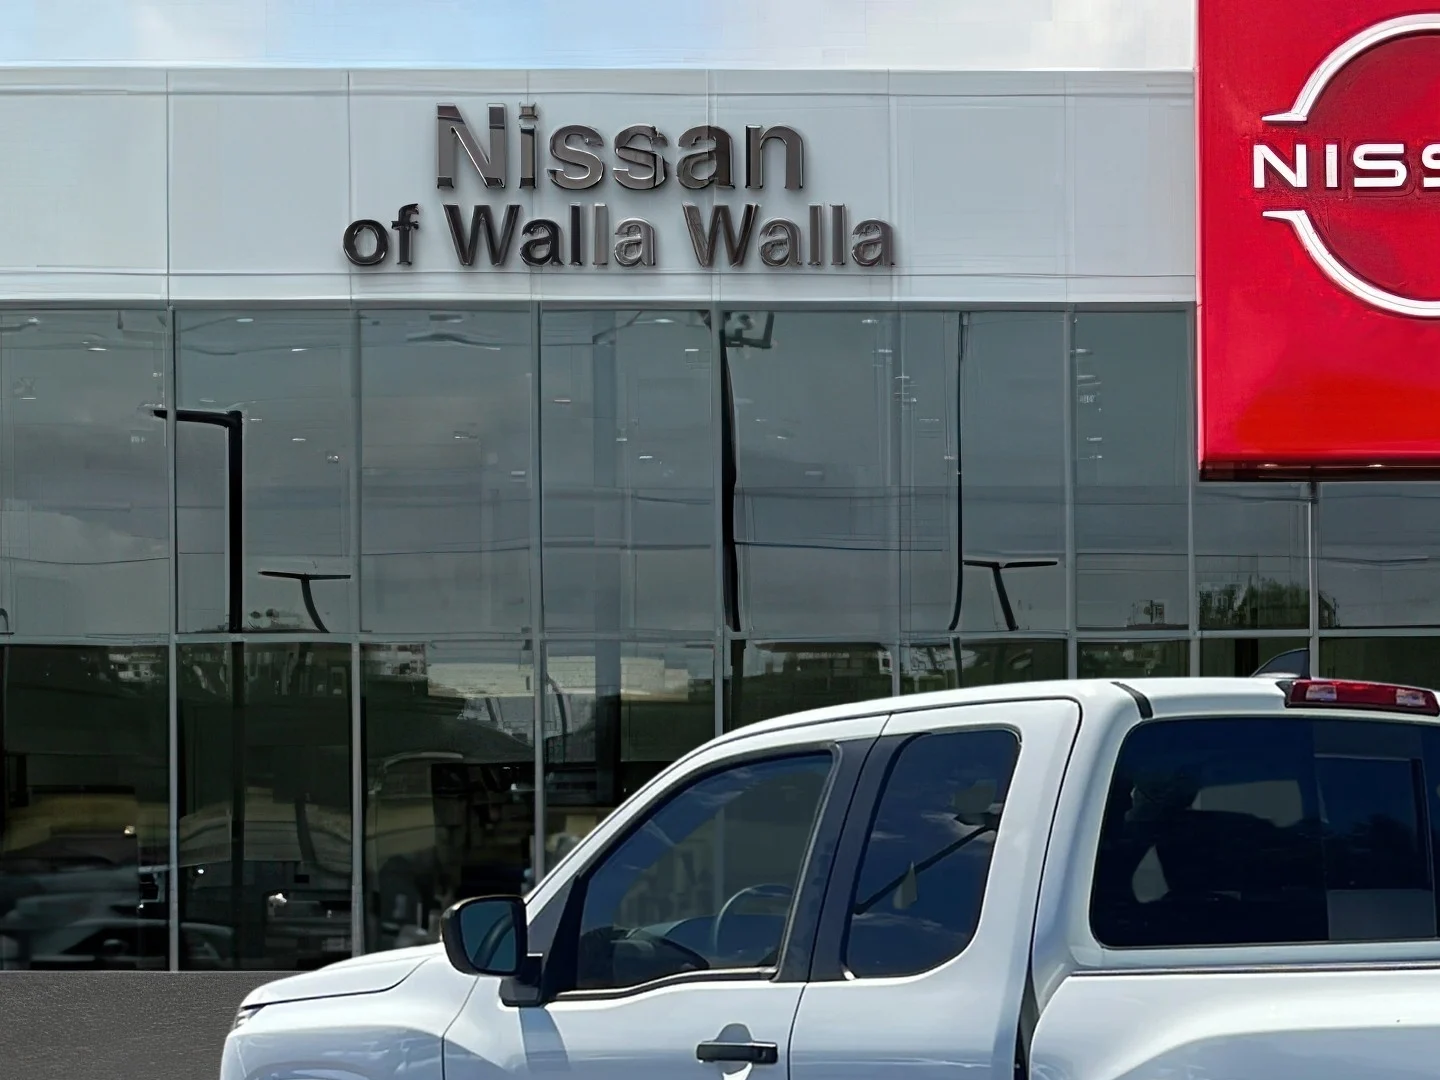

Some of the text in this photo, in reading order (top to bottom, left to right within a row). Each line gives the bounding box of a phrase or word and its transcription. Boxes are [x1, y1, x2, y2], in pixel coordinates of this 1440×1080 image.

[435, 102, 805, 191] Nissan
[341, 203, 895, 267] of Walla Walla
